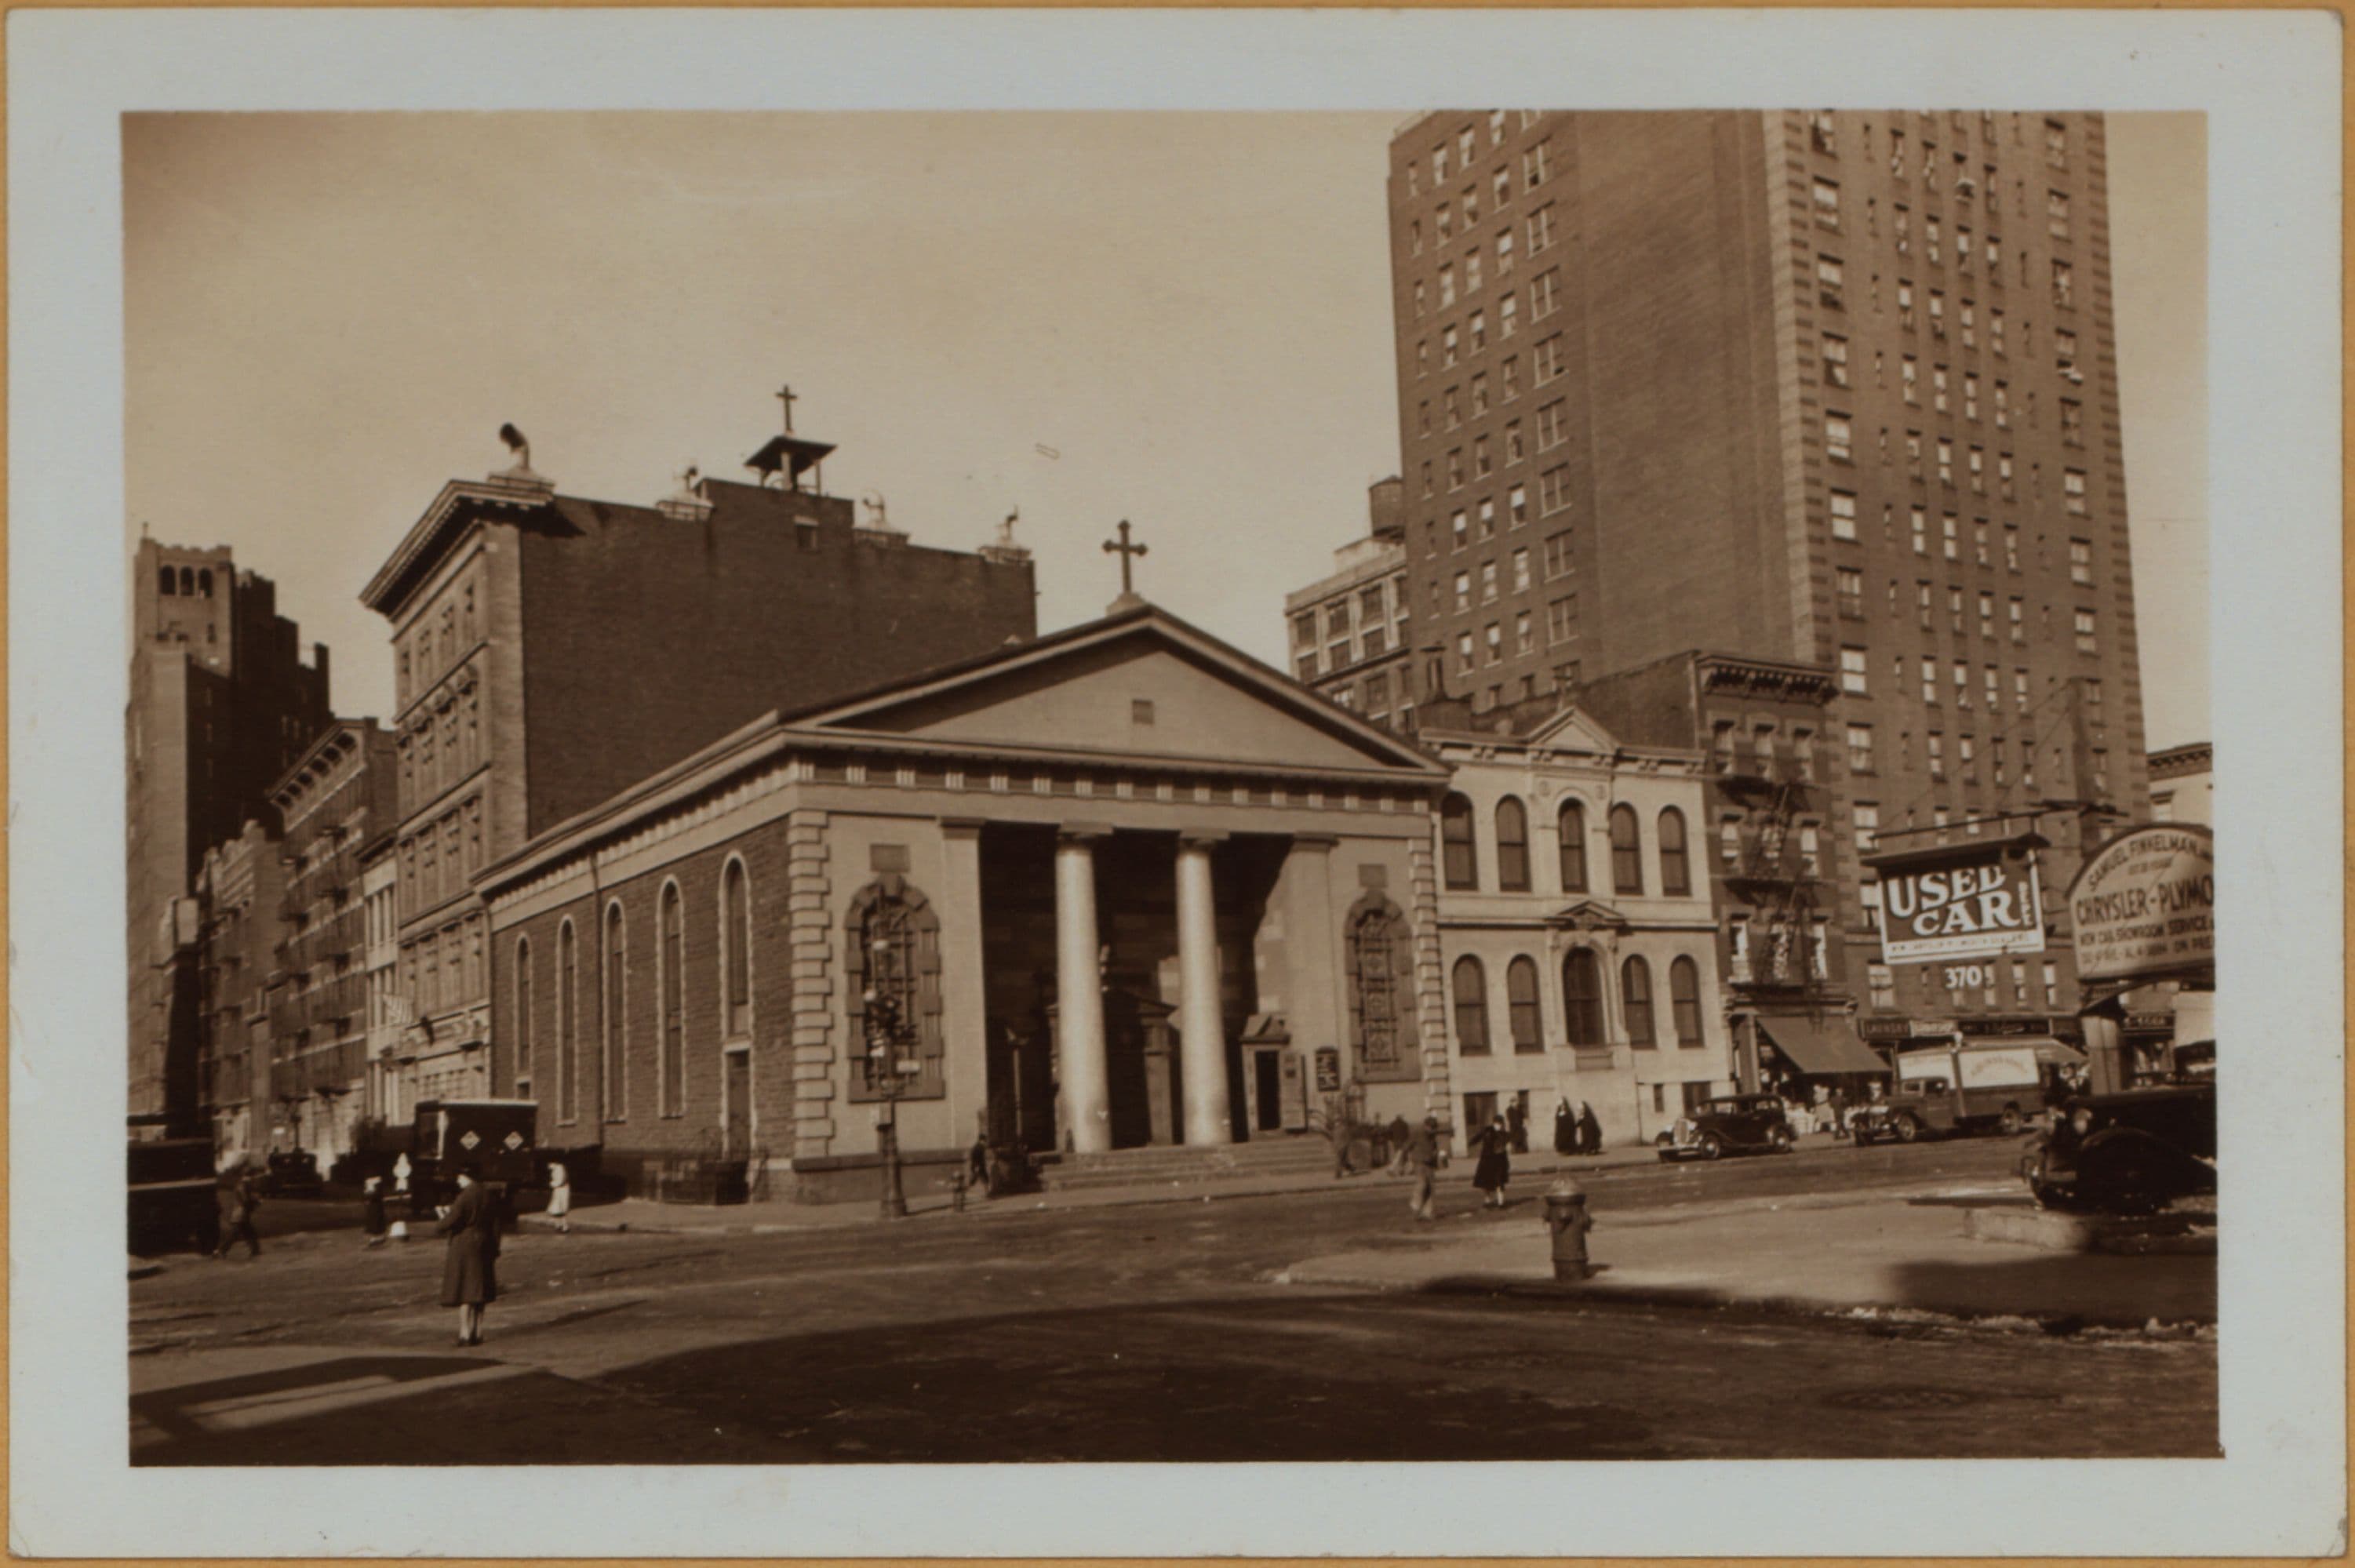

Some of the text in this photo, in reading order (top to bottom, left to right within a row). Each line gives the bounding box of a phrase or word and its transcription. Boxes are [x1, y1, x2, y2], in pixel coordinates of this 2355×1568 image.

[2088, 846, 2128, 892] SAMUEL
[2129, 834, 2197, 857] FINKELMAN
[1887, 865, 2007, 918] USED
[1913, 890, 2022, 936] CAR
[1945, 965, 1982, 989] 370
